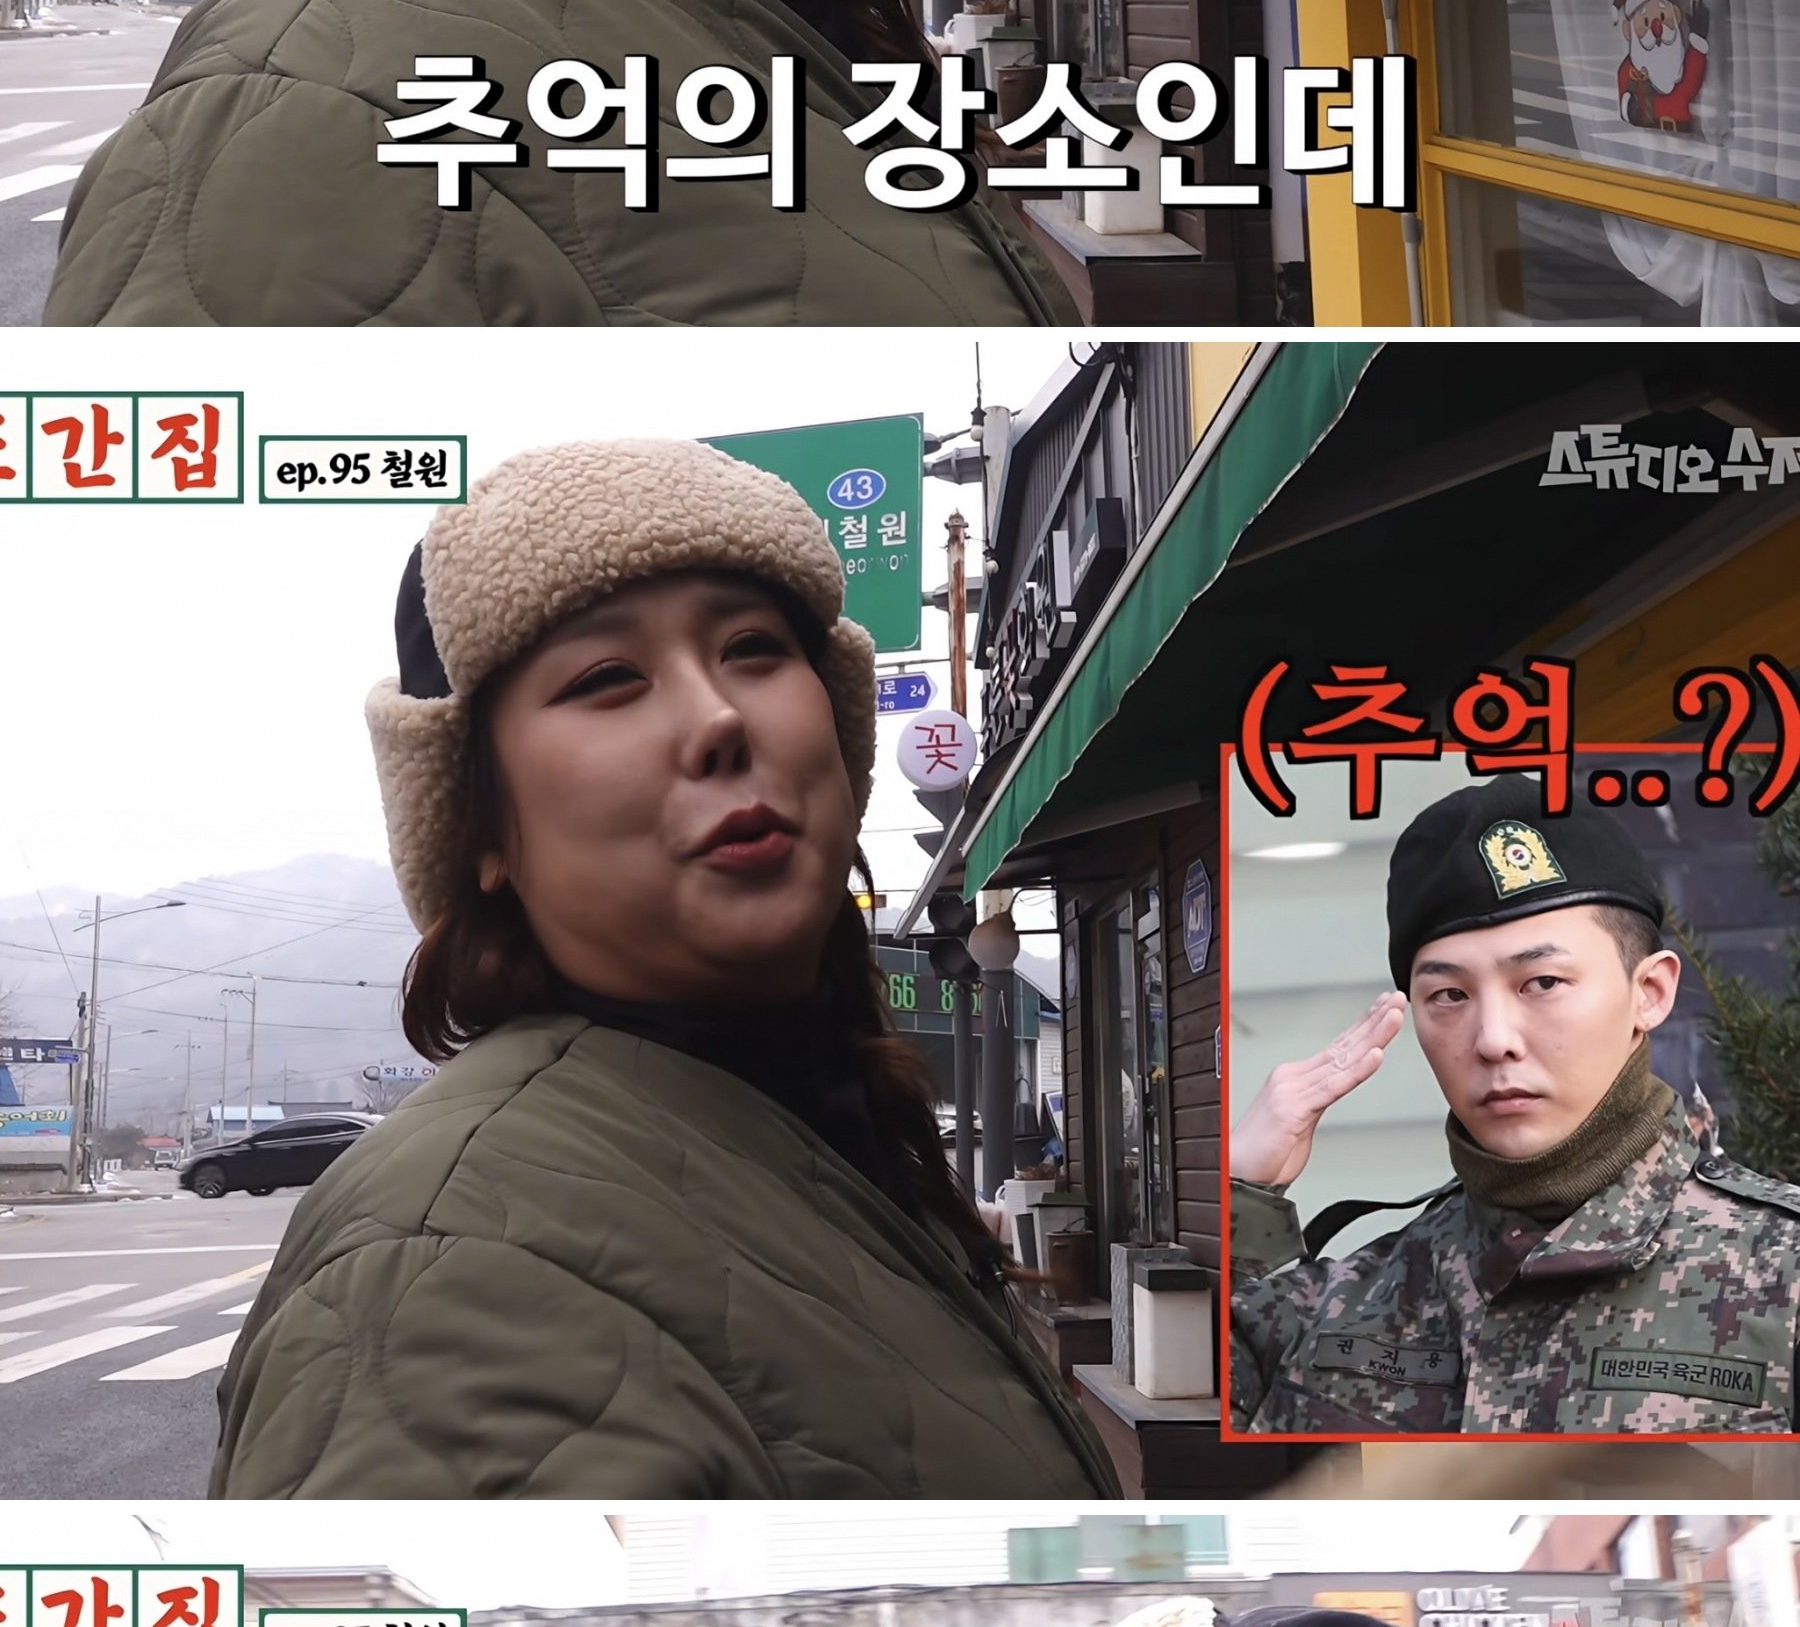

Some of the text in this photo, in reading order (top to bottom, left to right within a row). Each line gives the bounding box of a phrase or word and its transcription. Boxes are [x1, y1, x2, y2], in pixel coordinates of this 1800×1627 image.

[837, 475, 874, 503] 43
[822, 509, 908, 551] 철원
[878, 680, 926, 698] 로 24
[914, 723, 963, 775] 꽃
[1367, 1359, 1407, 1377] KWON
[1600, 1359, 1754, 1393] 대한민국 육군 ROKA
